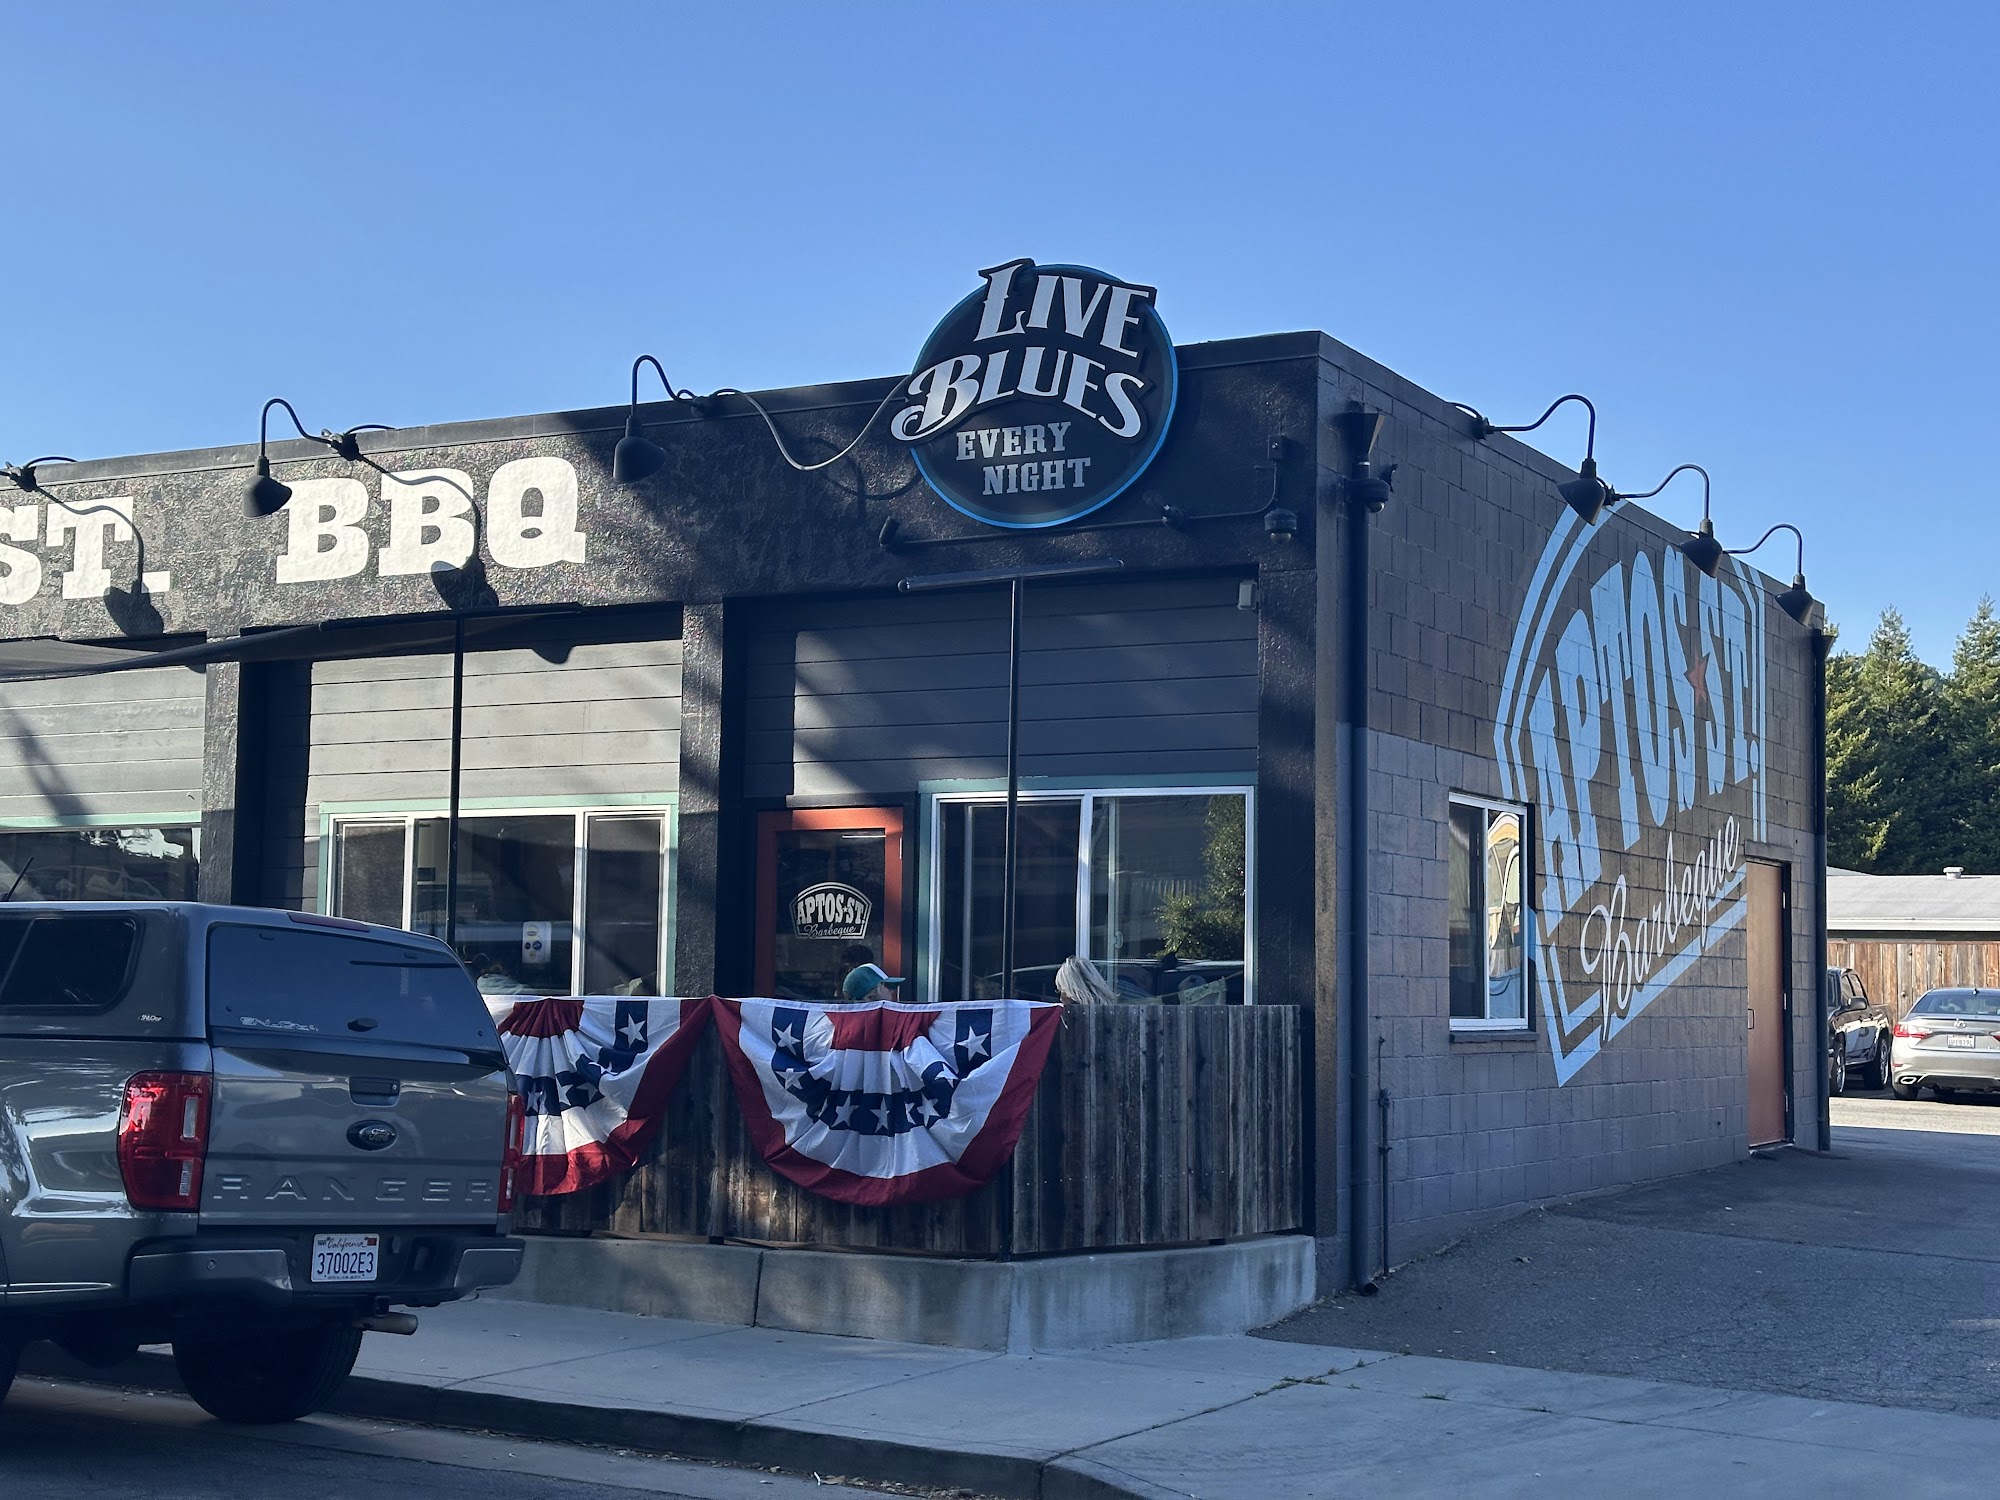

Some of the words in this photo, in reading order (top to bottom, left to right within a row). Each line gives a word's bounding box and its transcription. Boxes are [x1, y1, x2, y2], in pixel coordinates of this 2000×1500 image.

[973, 264, 1149, 358] LIVE
[891, 347, 1145, 441] BLUES
[956, 421, 1071, 461] EVERY
[983, 457, 1091, 496] NIGHT
[0, 497, 171, 605] ST.
[276, 456, 586, 584] BBQ
[1528, 544, 1696, 937] APTOS
[797, 893, 844, 925] APTOS
[1580, 815, 1740, 1041] Barbeque
[804, 924, 856, 939] Barbeque
[213, 1174, 492, 1201] RANGER
[317, 1252, 374, 1274] 37002E3
[328, 1237, 366, 1252] California
